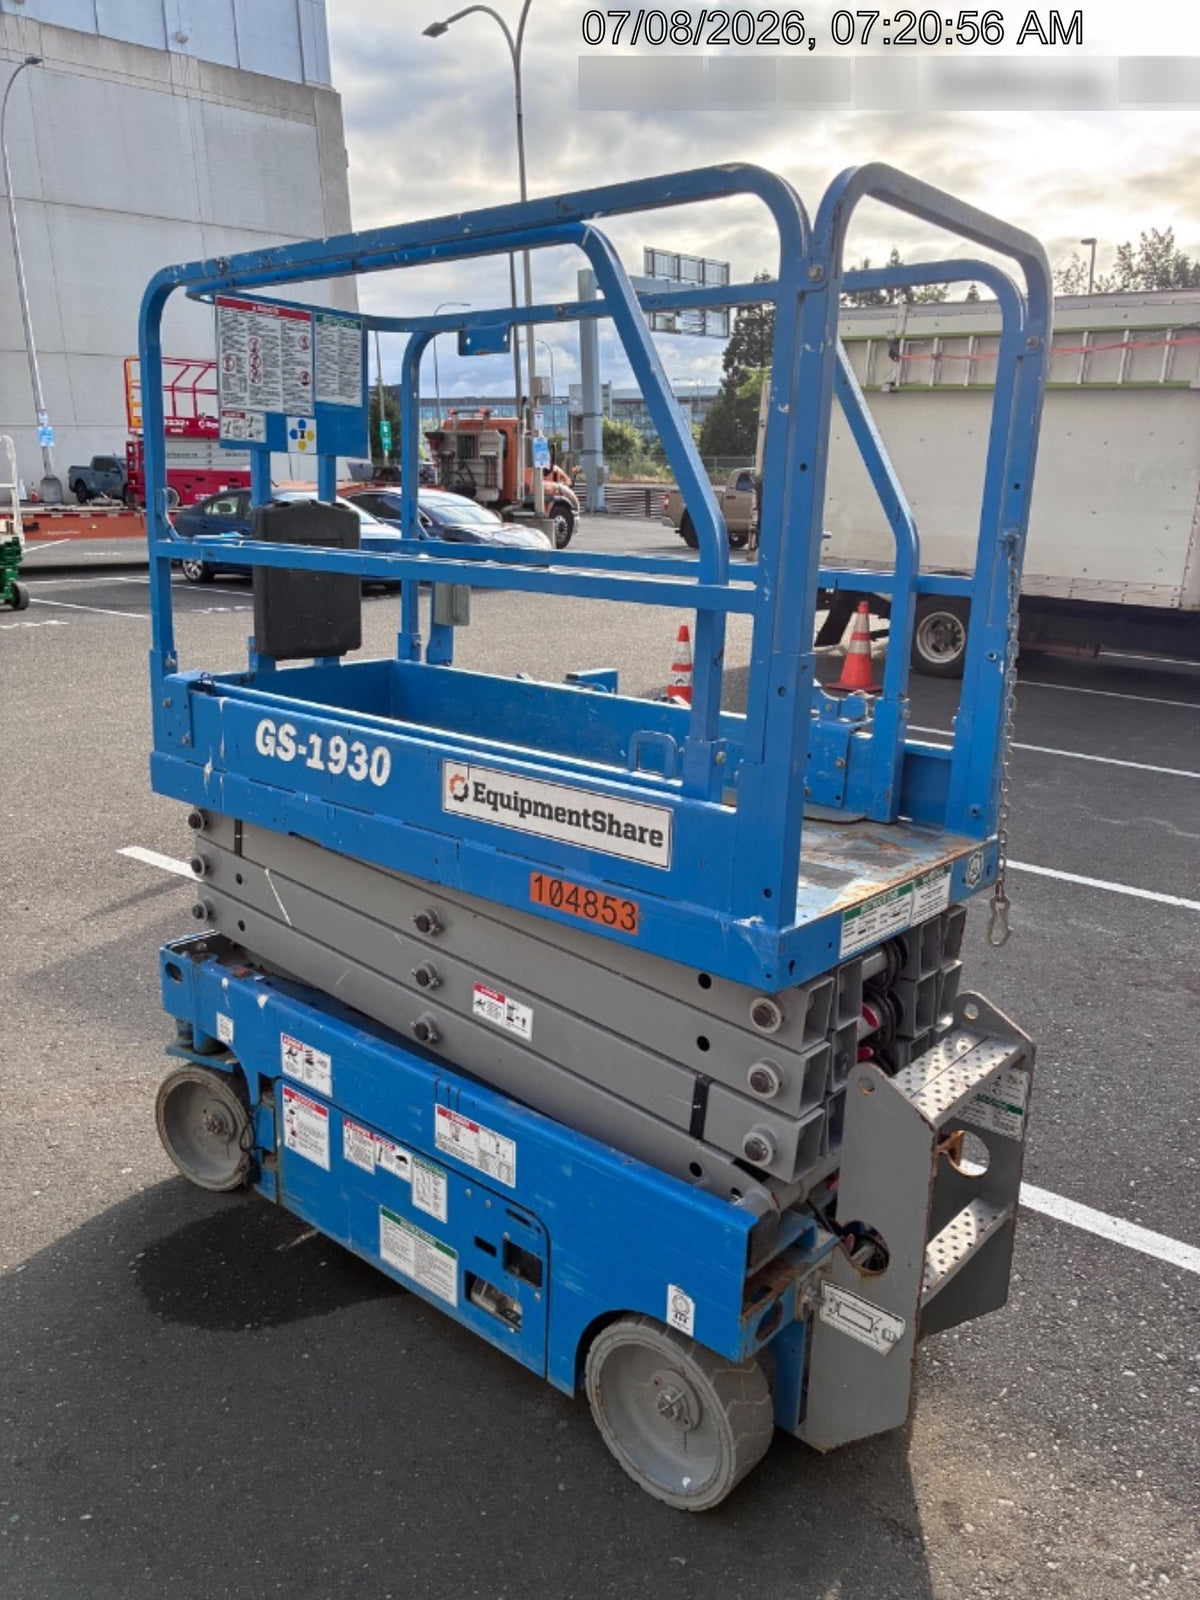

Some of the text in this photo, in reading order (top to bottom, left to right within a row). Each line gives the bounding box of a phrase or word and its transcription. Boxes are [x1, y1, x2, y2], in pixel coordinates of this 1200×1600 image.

[255, 718, 392, 787] GS-1930
[473, 782, 664, 848] EquipmentShare
[533, 874, 637, 931] 104853
